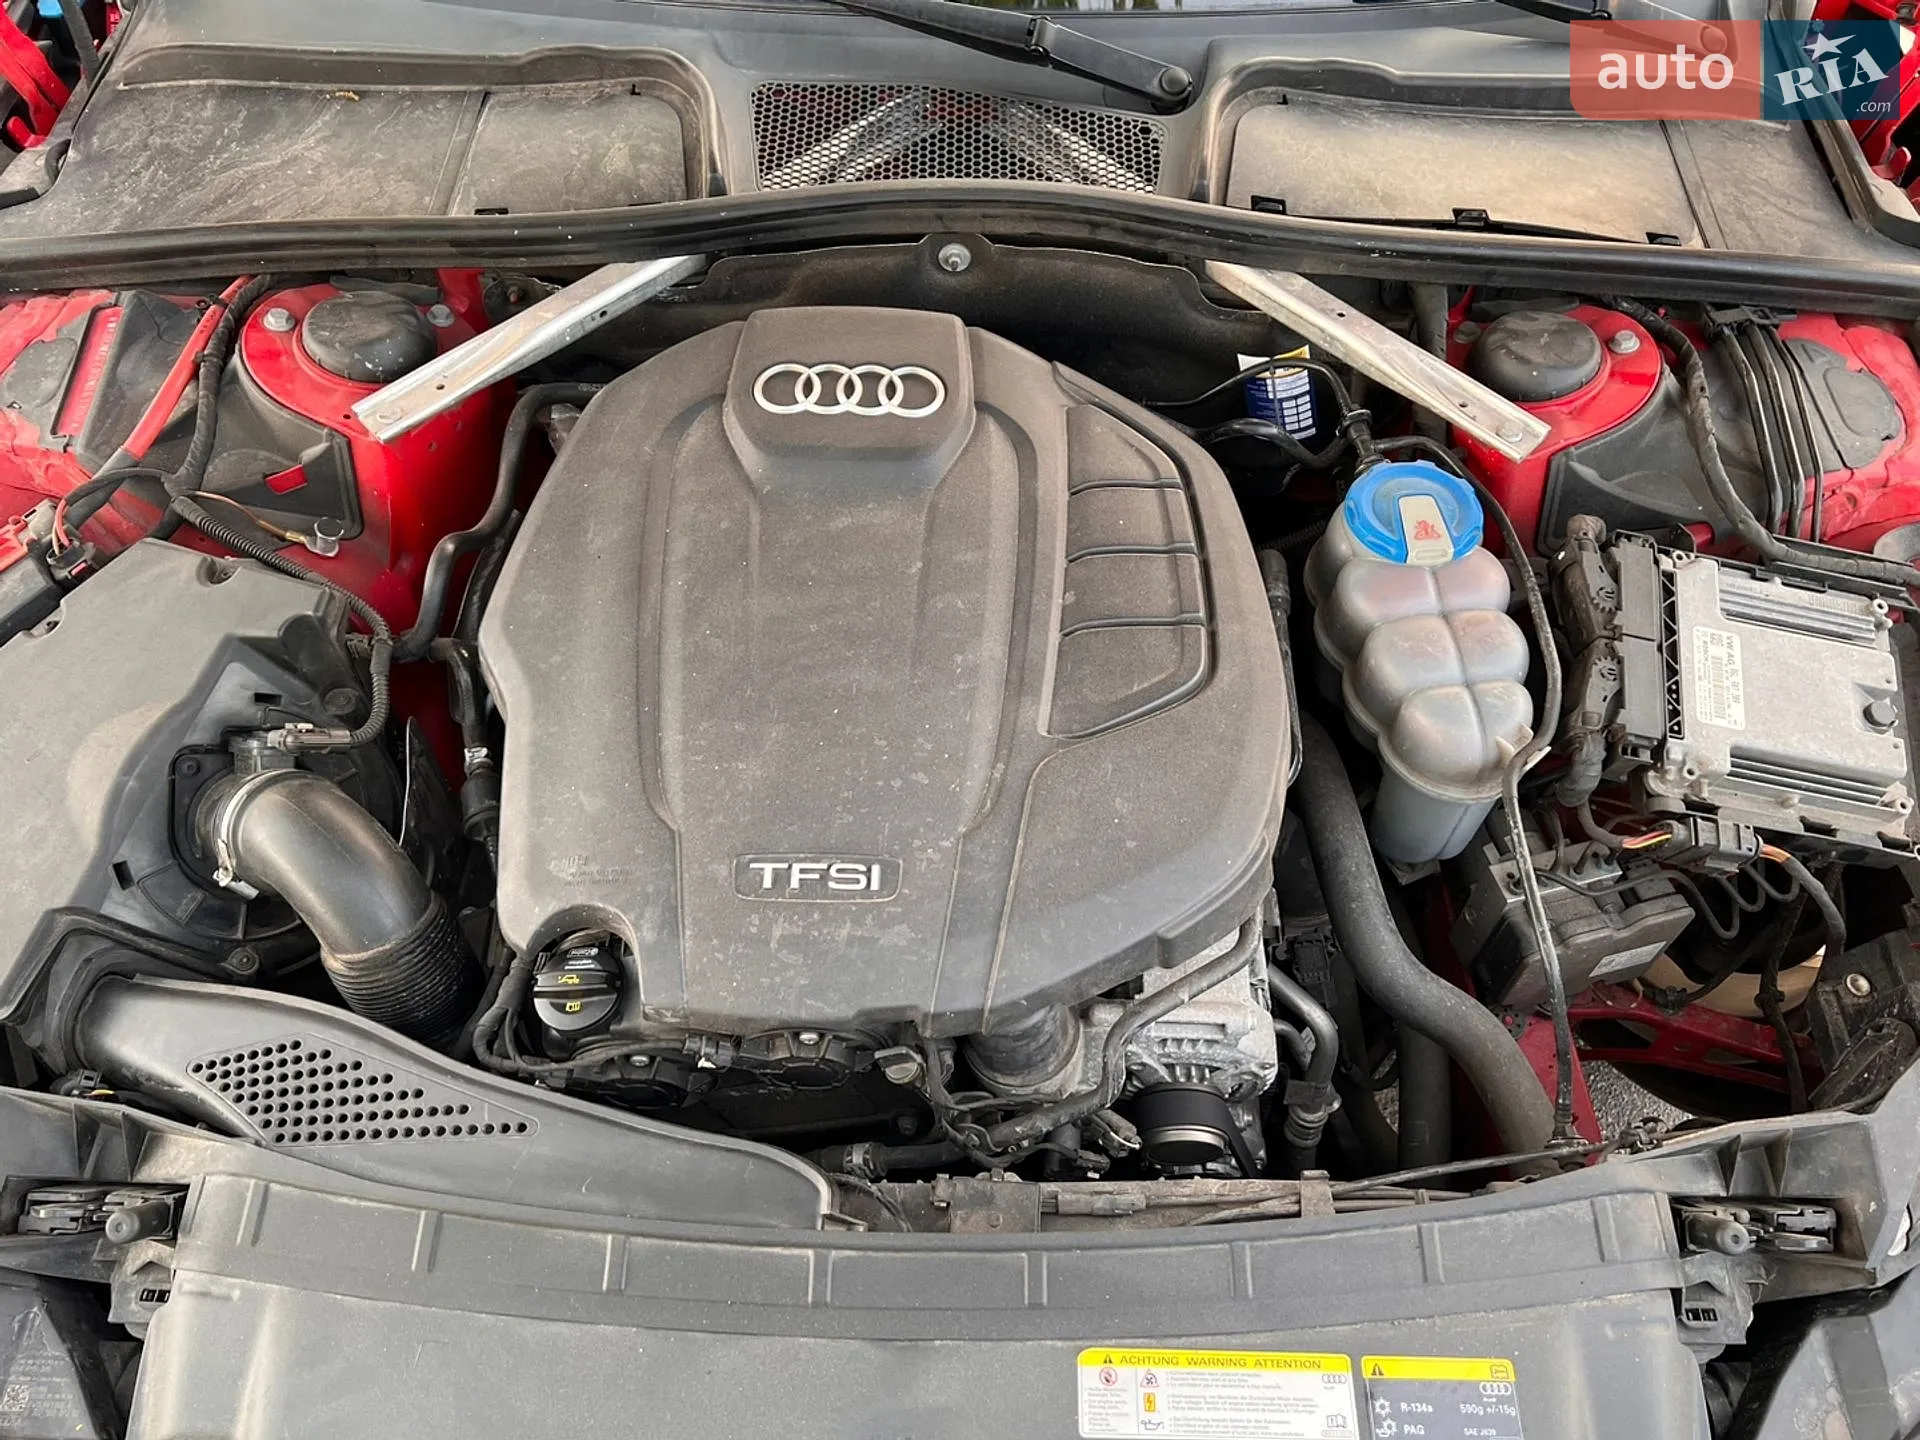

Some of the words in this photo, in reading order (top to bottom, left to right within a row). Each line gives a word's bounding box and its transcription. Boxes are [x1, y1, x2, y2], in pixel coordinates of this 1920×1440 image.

[749, 862, 881, 891] TFSI
[1120, 1355, 1180, 1366] ACHTUNG
[1186, 1357, 1248, 1368] WARNING
[1253, 1358, 1322, 1369] ATTENTION
[1400, 1402, 1434, 1414] R-134a
[1403, 1424, 1425, 1435] PAG
